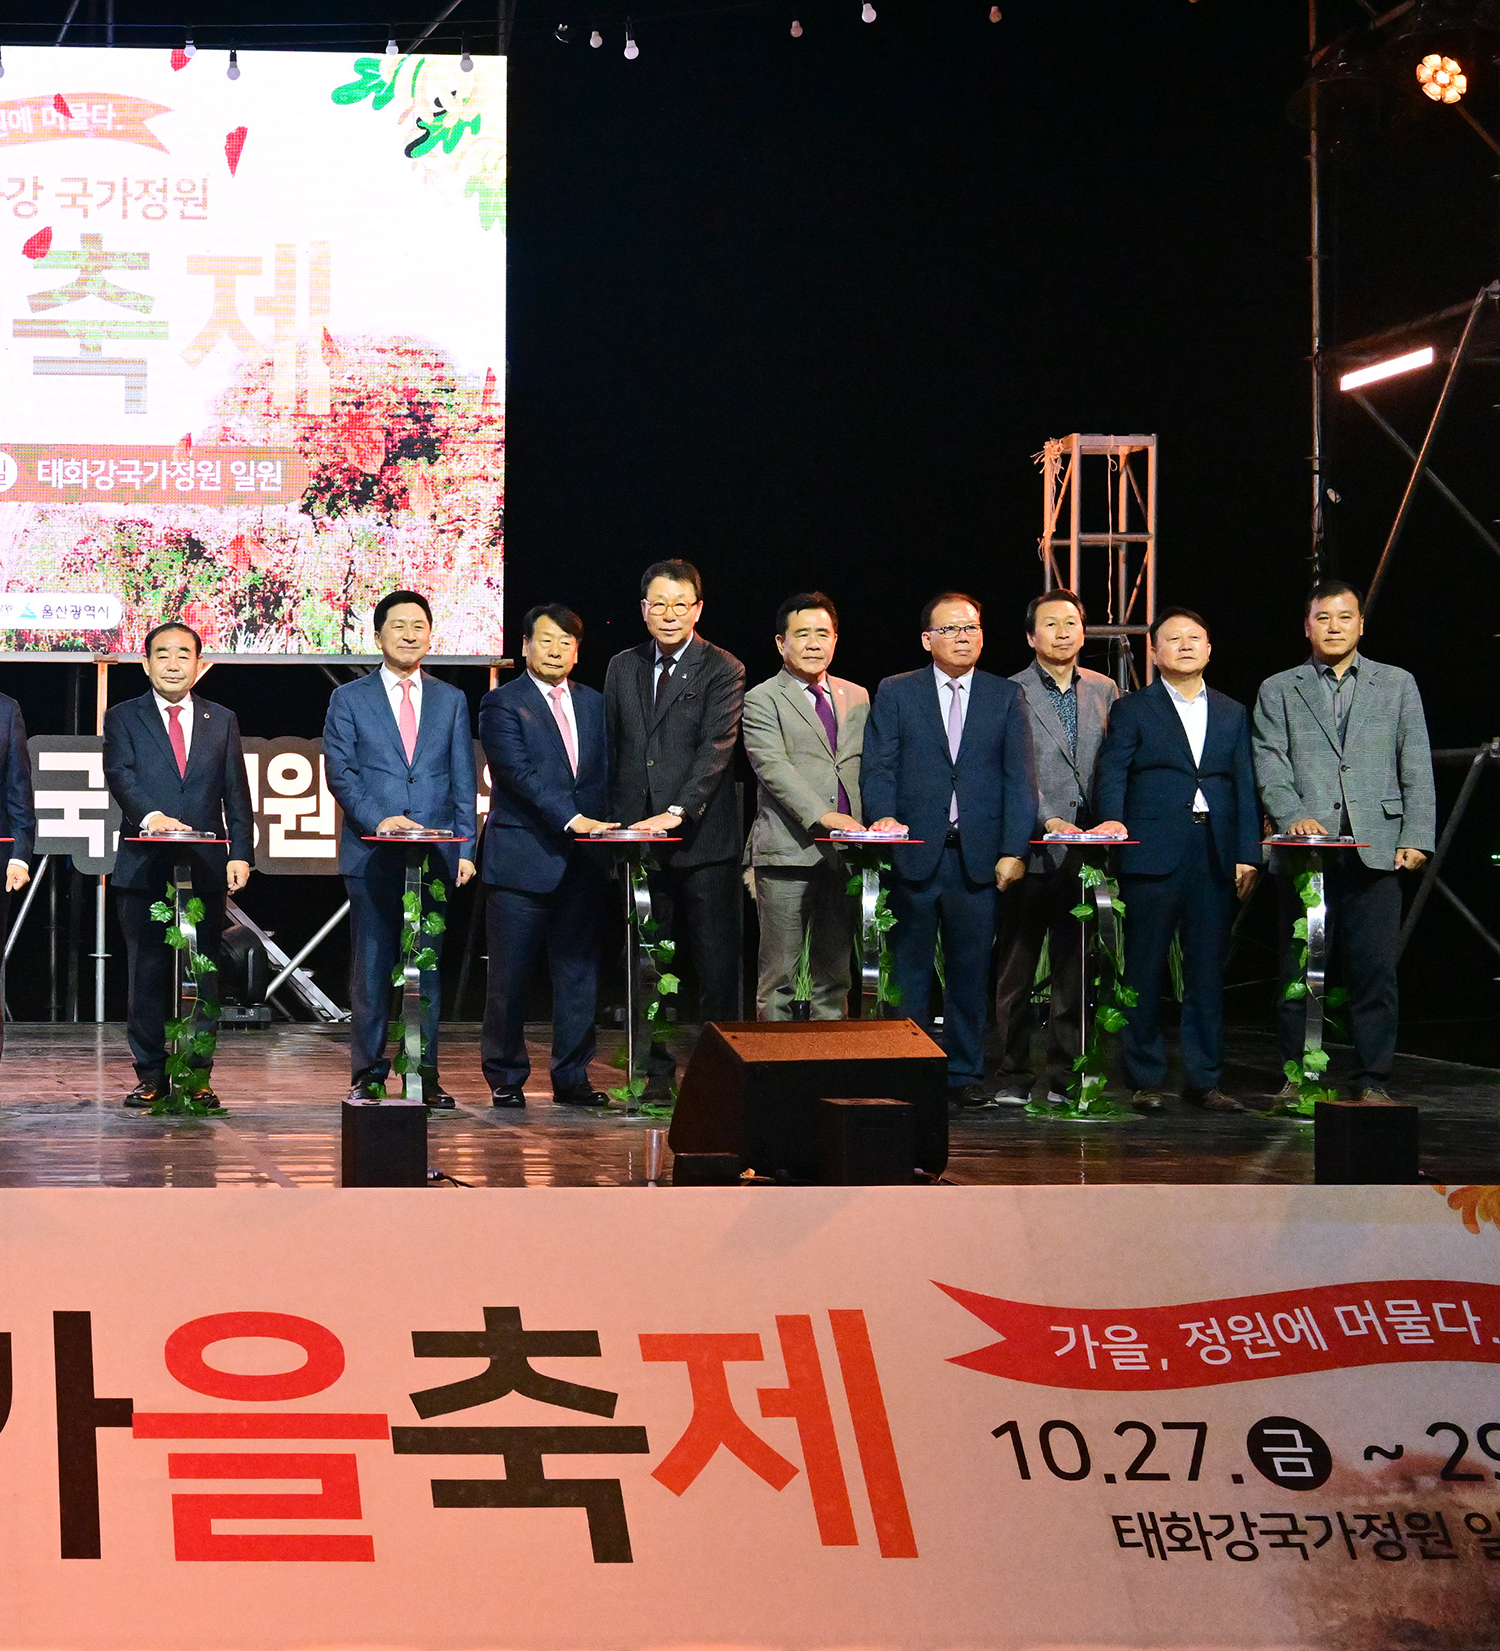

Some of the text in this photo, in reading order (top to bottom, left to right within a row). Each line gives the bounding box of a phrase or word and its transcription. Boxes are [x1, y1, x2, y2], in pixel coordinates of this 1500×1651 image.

[55, 176, 209, 221] 국가정원
[36, 458, 221, 492] 태화강국가정원
[230, 460, 283, 492] 일원
[41, 604, 110, 620] 울산광역시
[1049, 1323, 1169, 1371] 가을,
[1179, 1306, 1324, 1365] 정원에
[1111, 1510, 1459, 1562] 태화강국가정원
